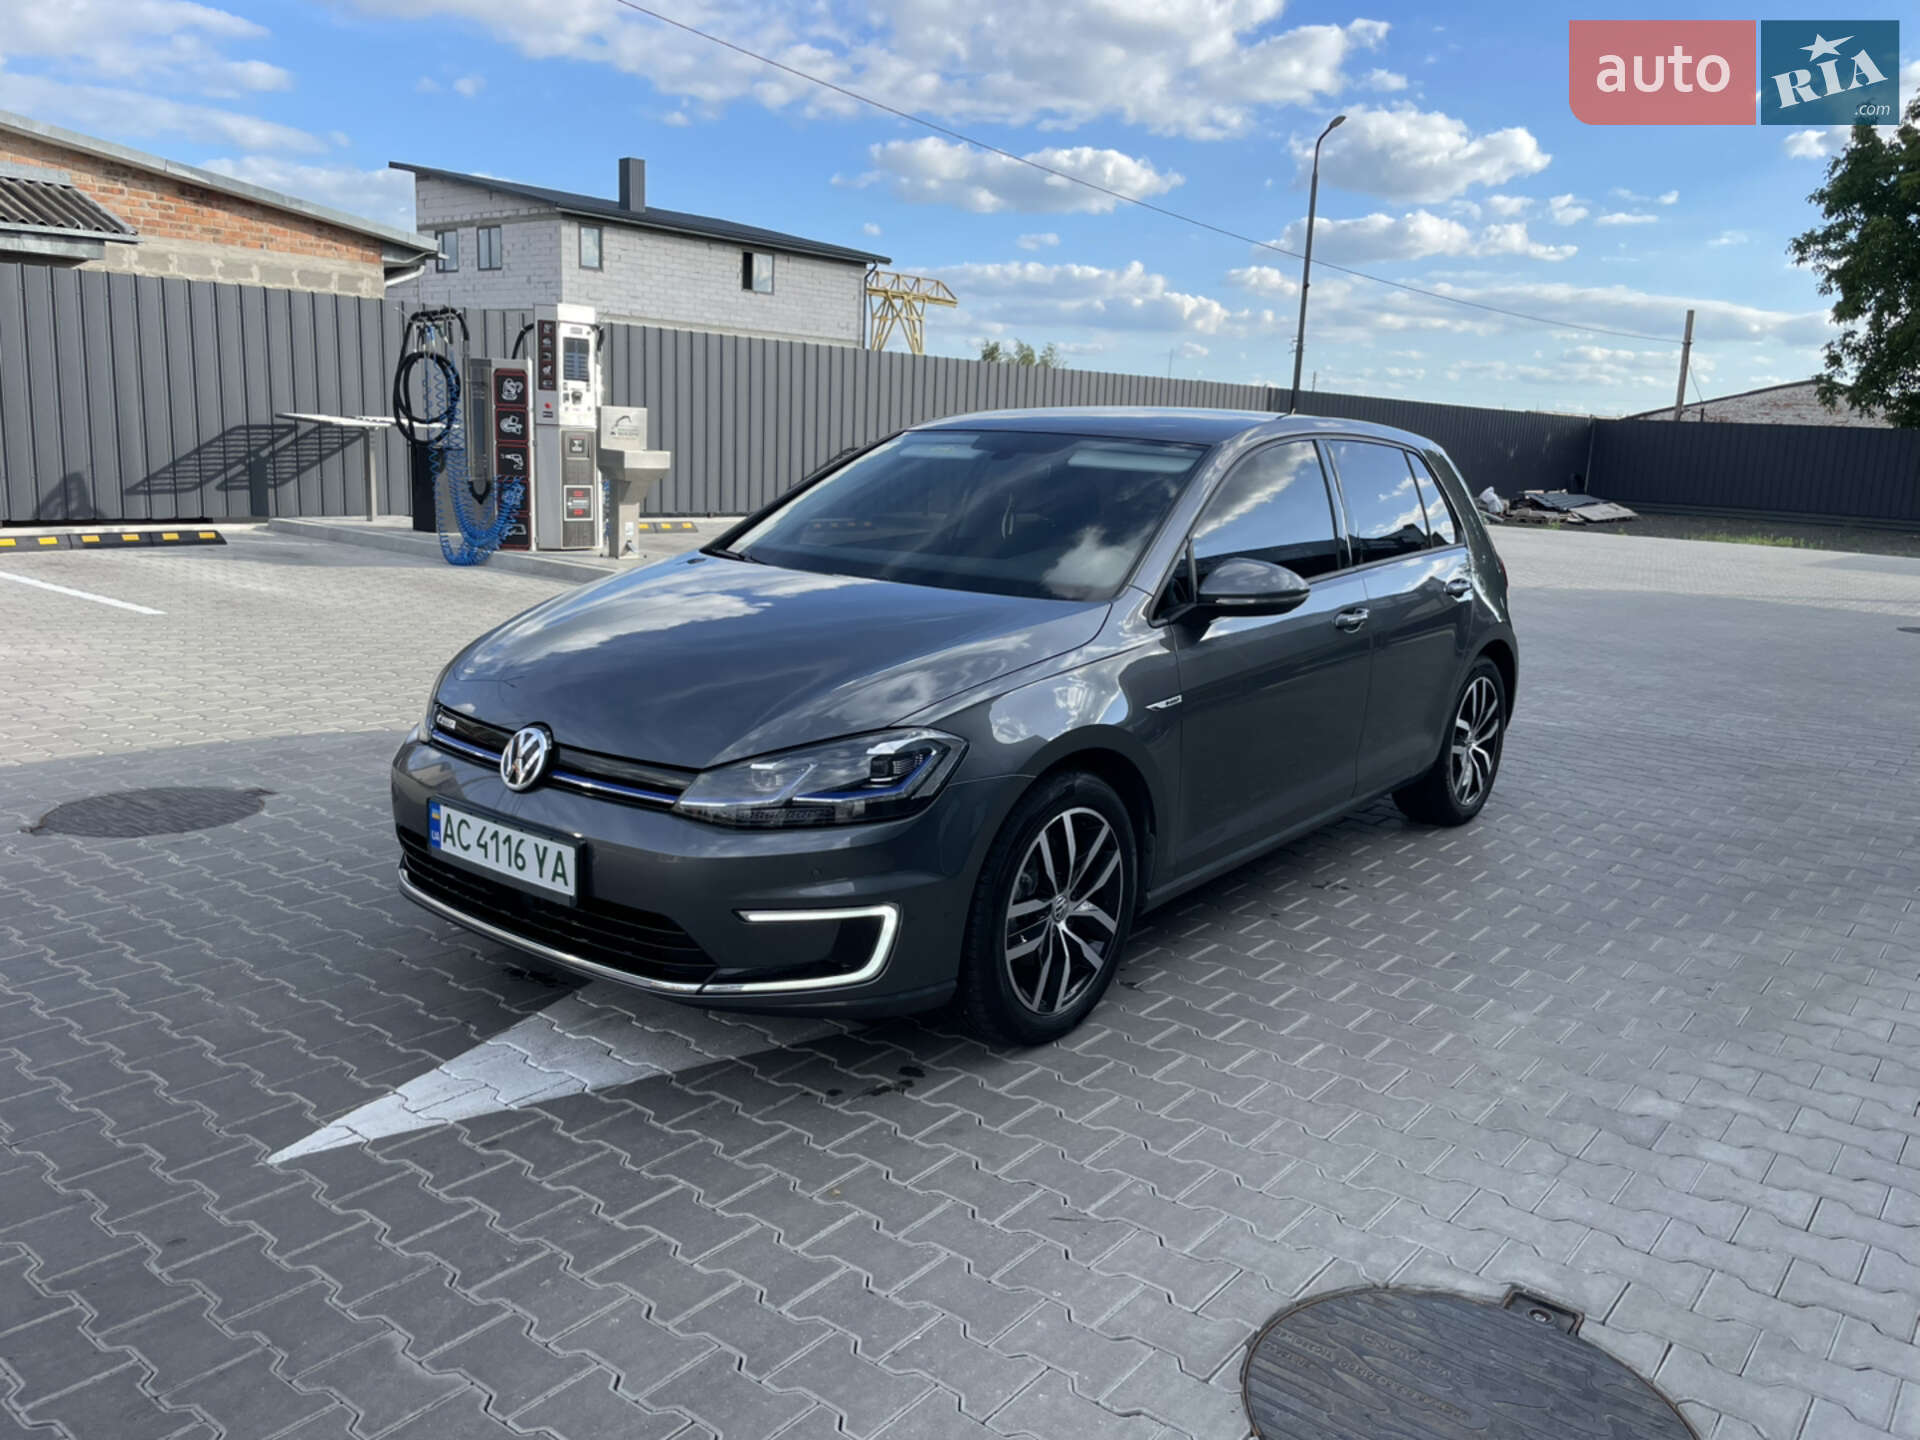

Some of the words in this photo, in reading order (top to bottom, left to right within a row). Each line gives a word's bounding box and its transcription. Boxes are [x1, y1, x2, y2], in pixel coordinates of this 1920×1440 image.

[443, 813, 472, 852] AC
[476, 826, 527, 872] 4116
[534, 843, 569, 887] YA
